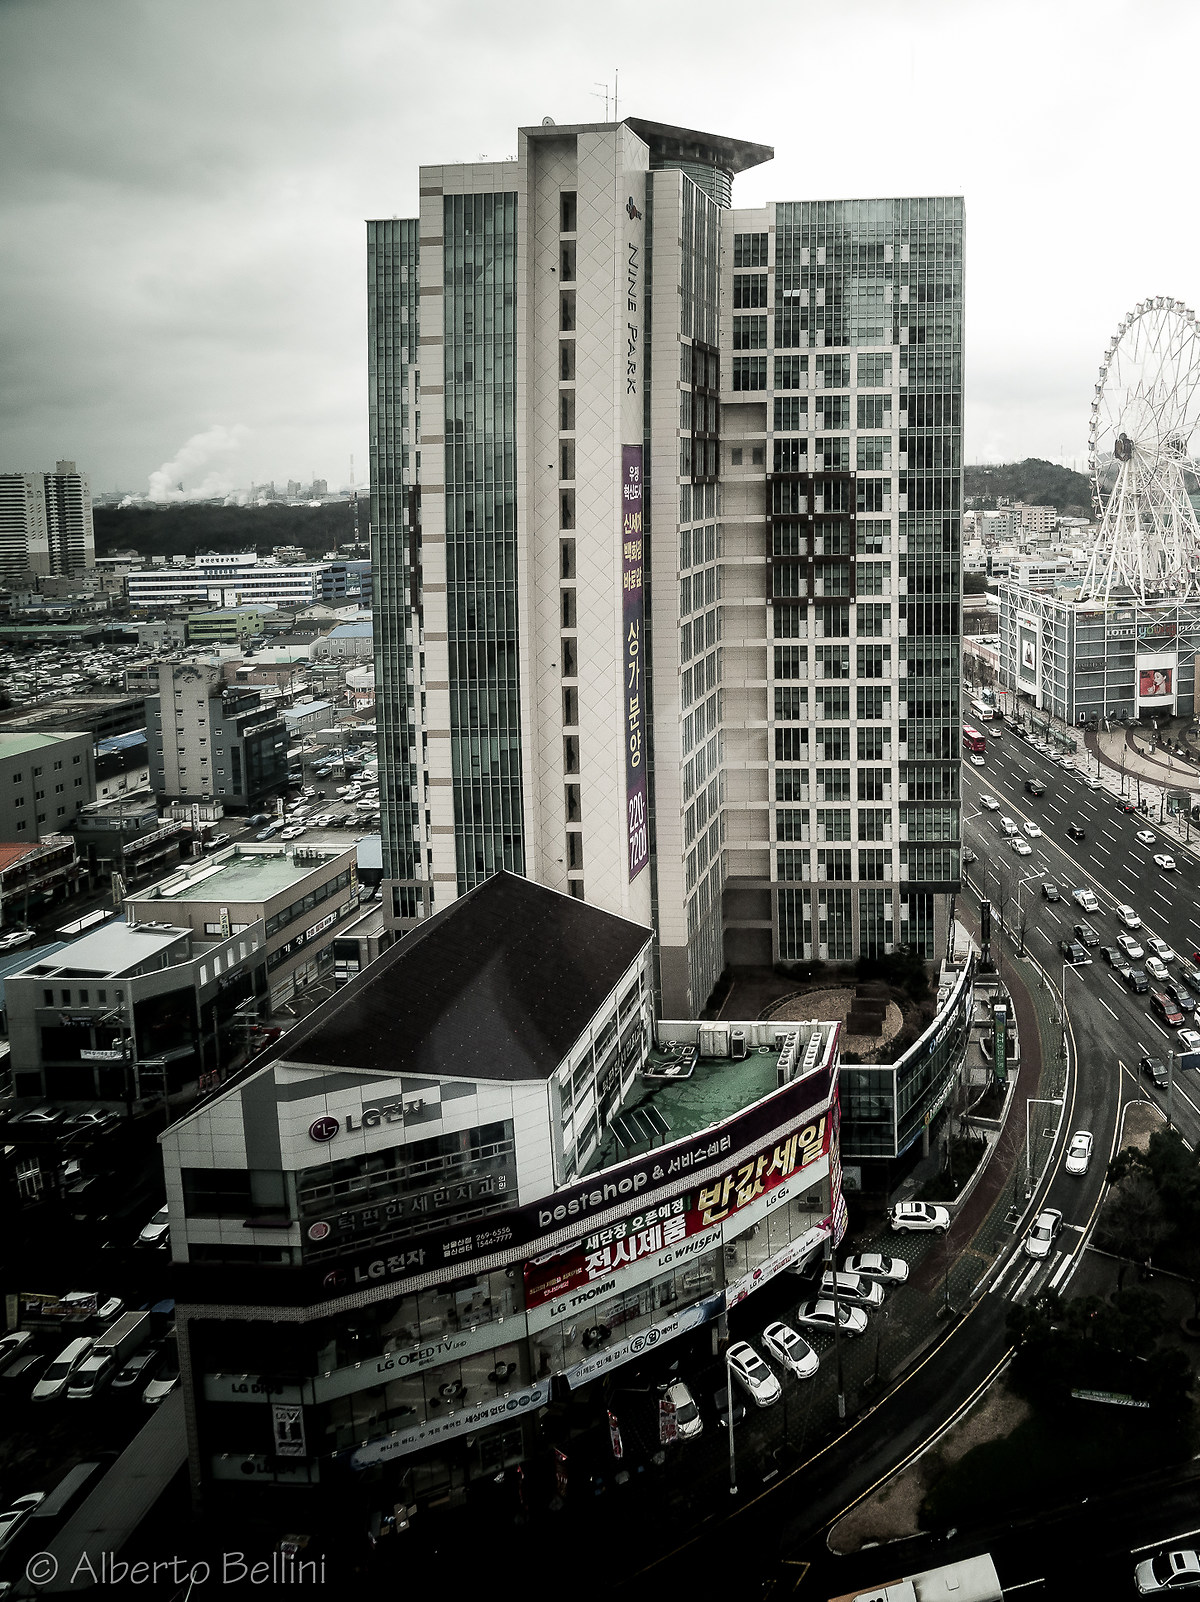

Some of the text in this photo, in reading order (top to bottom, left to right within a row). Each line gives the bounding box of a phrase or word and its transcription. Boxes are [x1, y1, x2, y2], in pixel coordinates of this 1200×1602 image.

[627, 242, 639, 395] NINE PARK
[1107, 628, 1136, 637] LOTTE
[1138, 624, 1177, 639] young
[345, 1098, 428, 1133] LG전자
[538, 1135, 731, 1227] bestshop & 서비스센터
[765, 1194, 777, 1208] LG
[475, 1226, 511, 1242] 269-6556
[476, 1233, 513, 1248] 1544-7777
[585, 1197, 685, 1251] 새단장 오픈예정
[584, 1215, 687, 1280] 전시제품
[658, 1231, 722, 1267] LG WHISEN
[353, 1248, 427, 1284] LG전자
[550, 1279, 616, 1318] LG TROMM
[377, 1359, 395, 1373] LG
[437, 1341, 454, 1354] TV
[232, 1384, 248, 1393] LG
